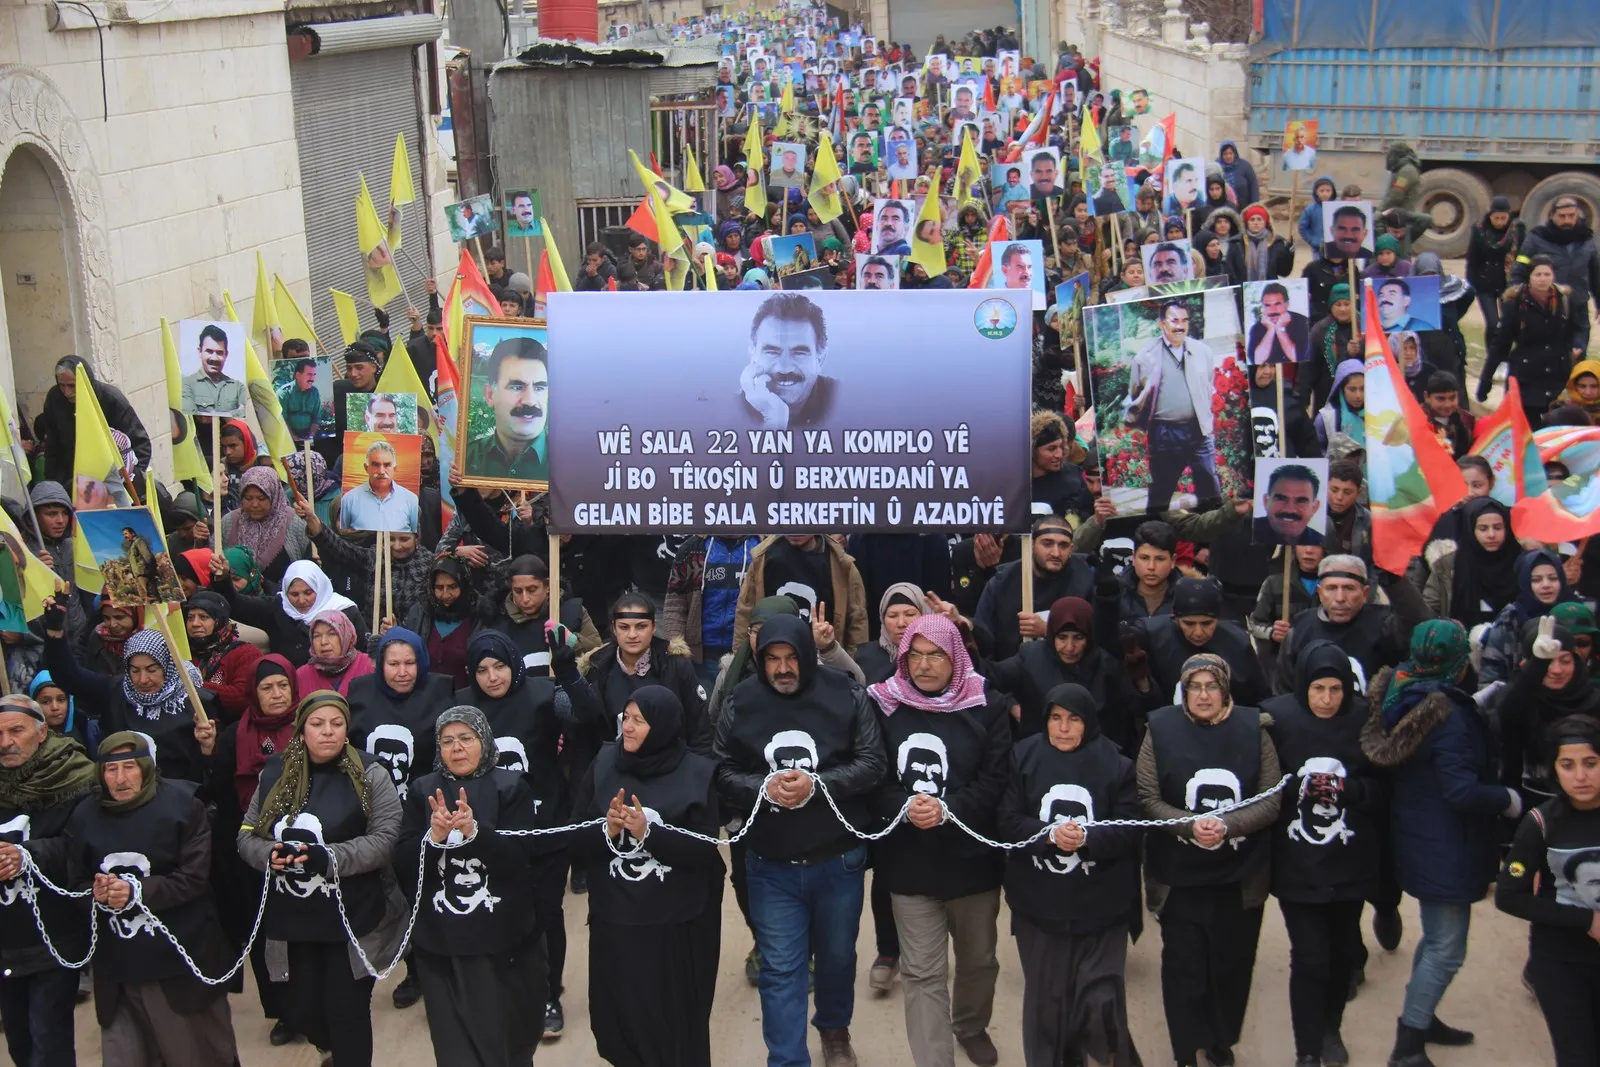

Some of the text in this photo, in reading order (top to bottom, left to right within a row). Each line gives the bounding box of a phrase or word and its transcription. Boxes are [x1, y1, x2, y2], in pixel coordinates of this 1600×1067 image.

[598, 423, 969, 454] WÊ SALA 22 YAN YA KOMPLO YÊ
[627, 466, 656, 490] BO
[669, 460, 758, 496] TÊKOŞÎN
[769, 460, 784, 489] Û
[795, 459, 936, 489] BERXWEDANÎ
[939, 466, 969, 489] YA
[574, 502, 641, 526] GELAN
[704, 502, 757, 525] SALA
[887, 495, 902, 525] Û
[912, 495, 1004, 525] AZADÎYÊ
[705, 566, 726, 581] 48
